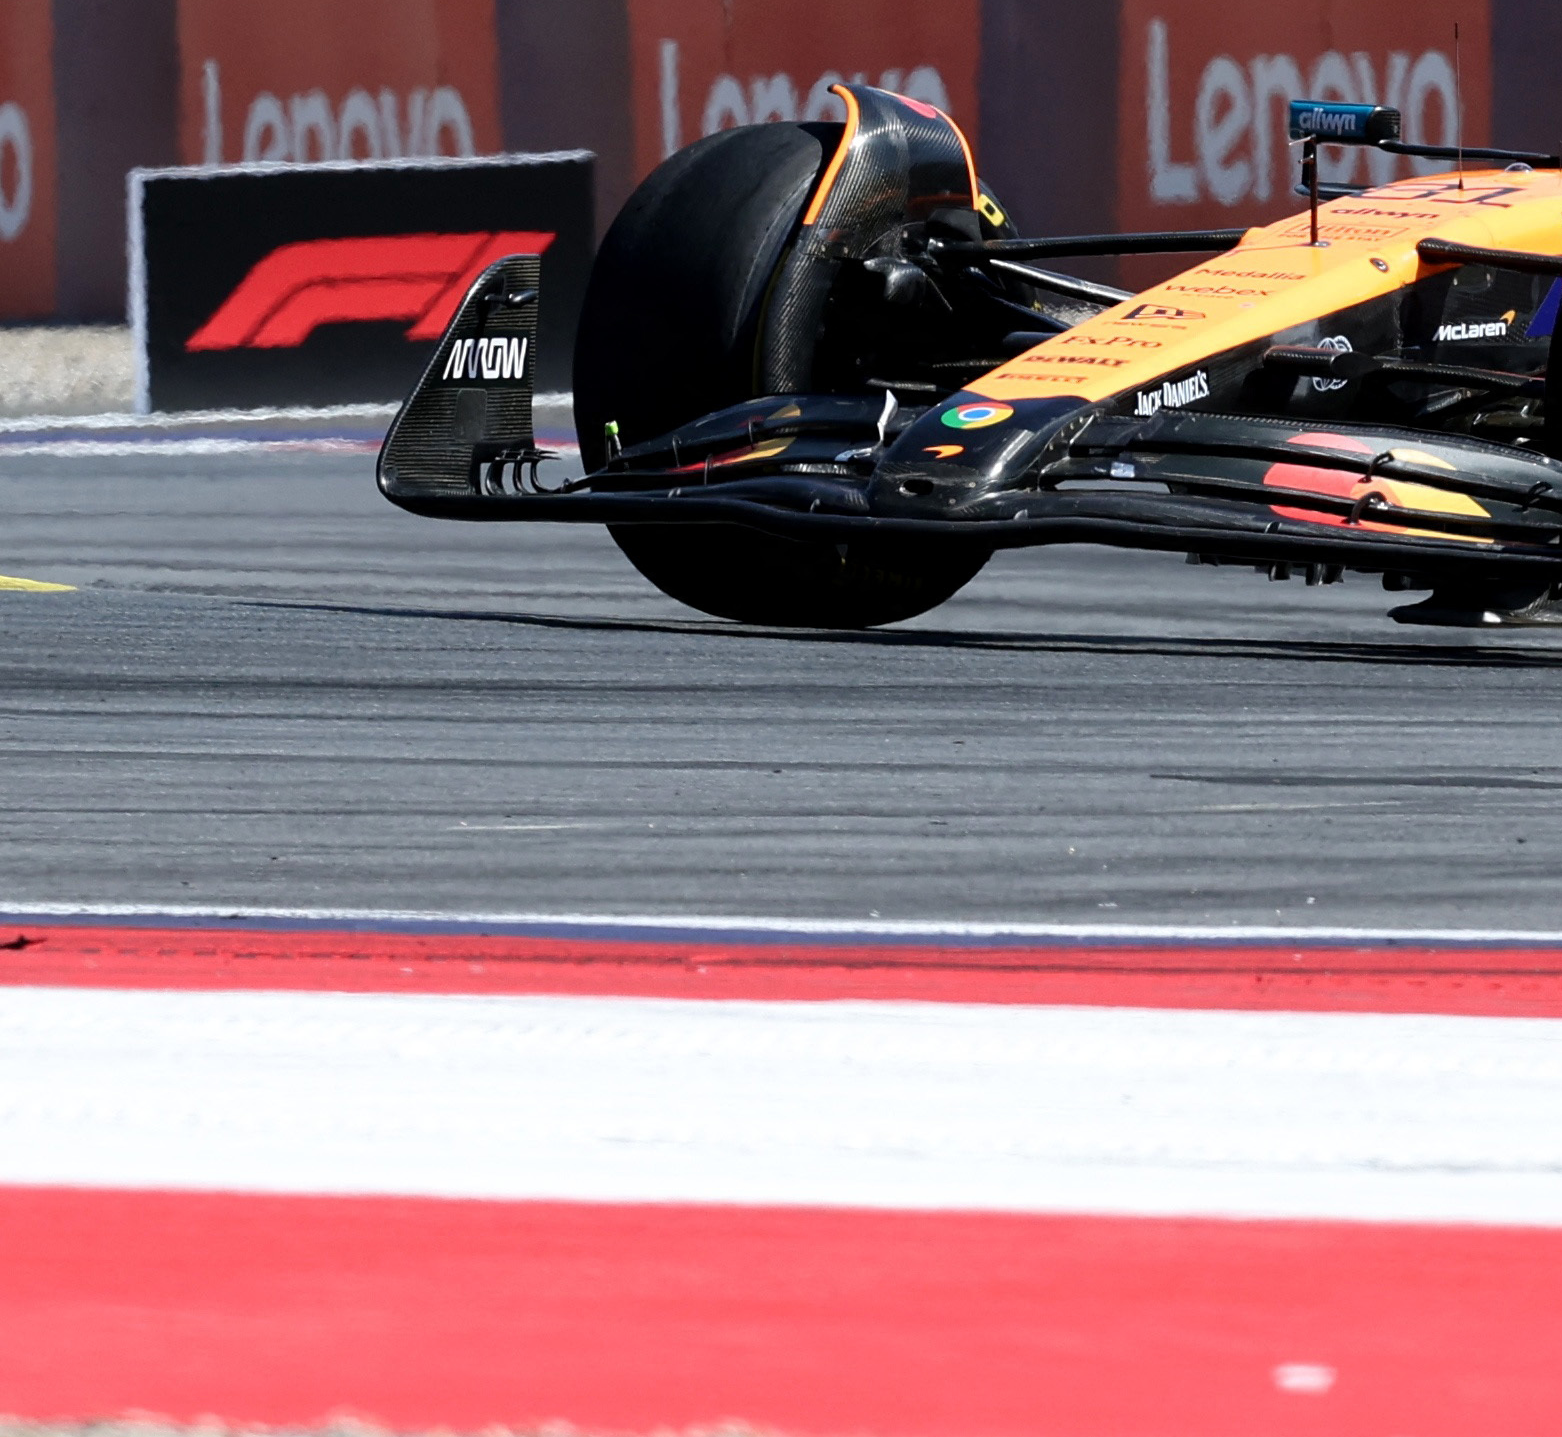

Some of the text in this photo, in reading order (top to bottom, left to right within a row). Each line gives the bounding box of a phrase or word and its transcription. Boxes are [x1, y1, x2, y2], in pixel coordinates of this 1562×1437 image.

[1299, 107, 1357, 136] allwyn
[1329, 207, 1441, 220] allwyn
[1195, 267, 1306, 281] Medallia
[1164, 283, 1277, 297] webex
[1432, 320, 1507, 343] McLaren
[1060, 334, 1164, 349] FxPro
[1133, 390, 1163, 416] JACK
